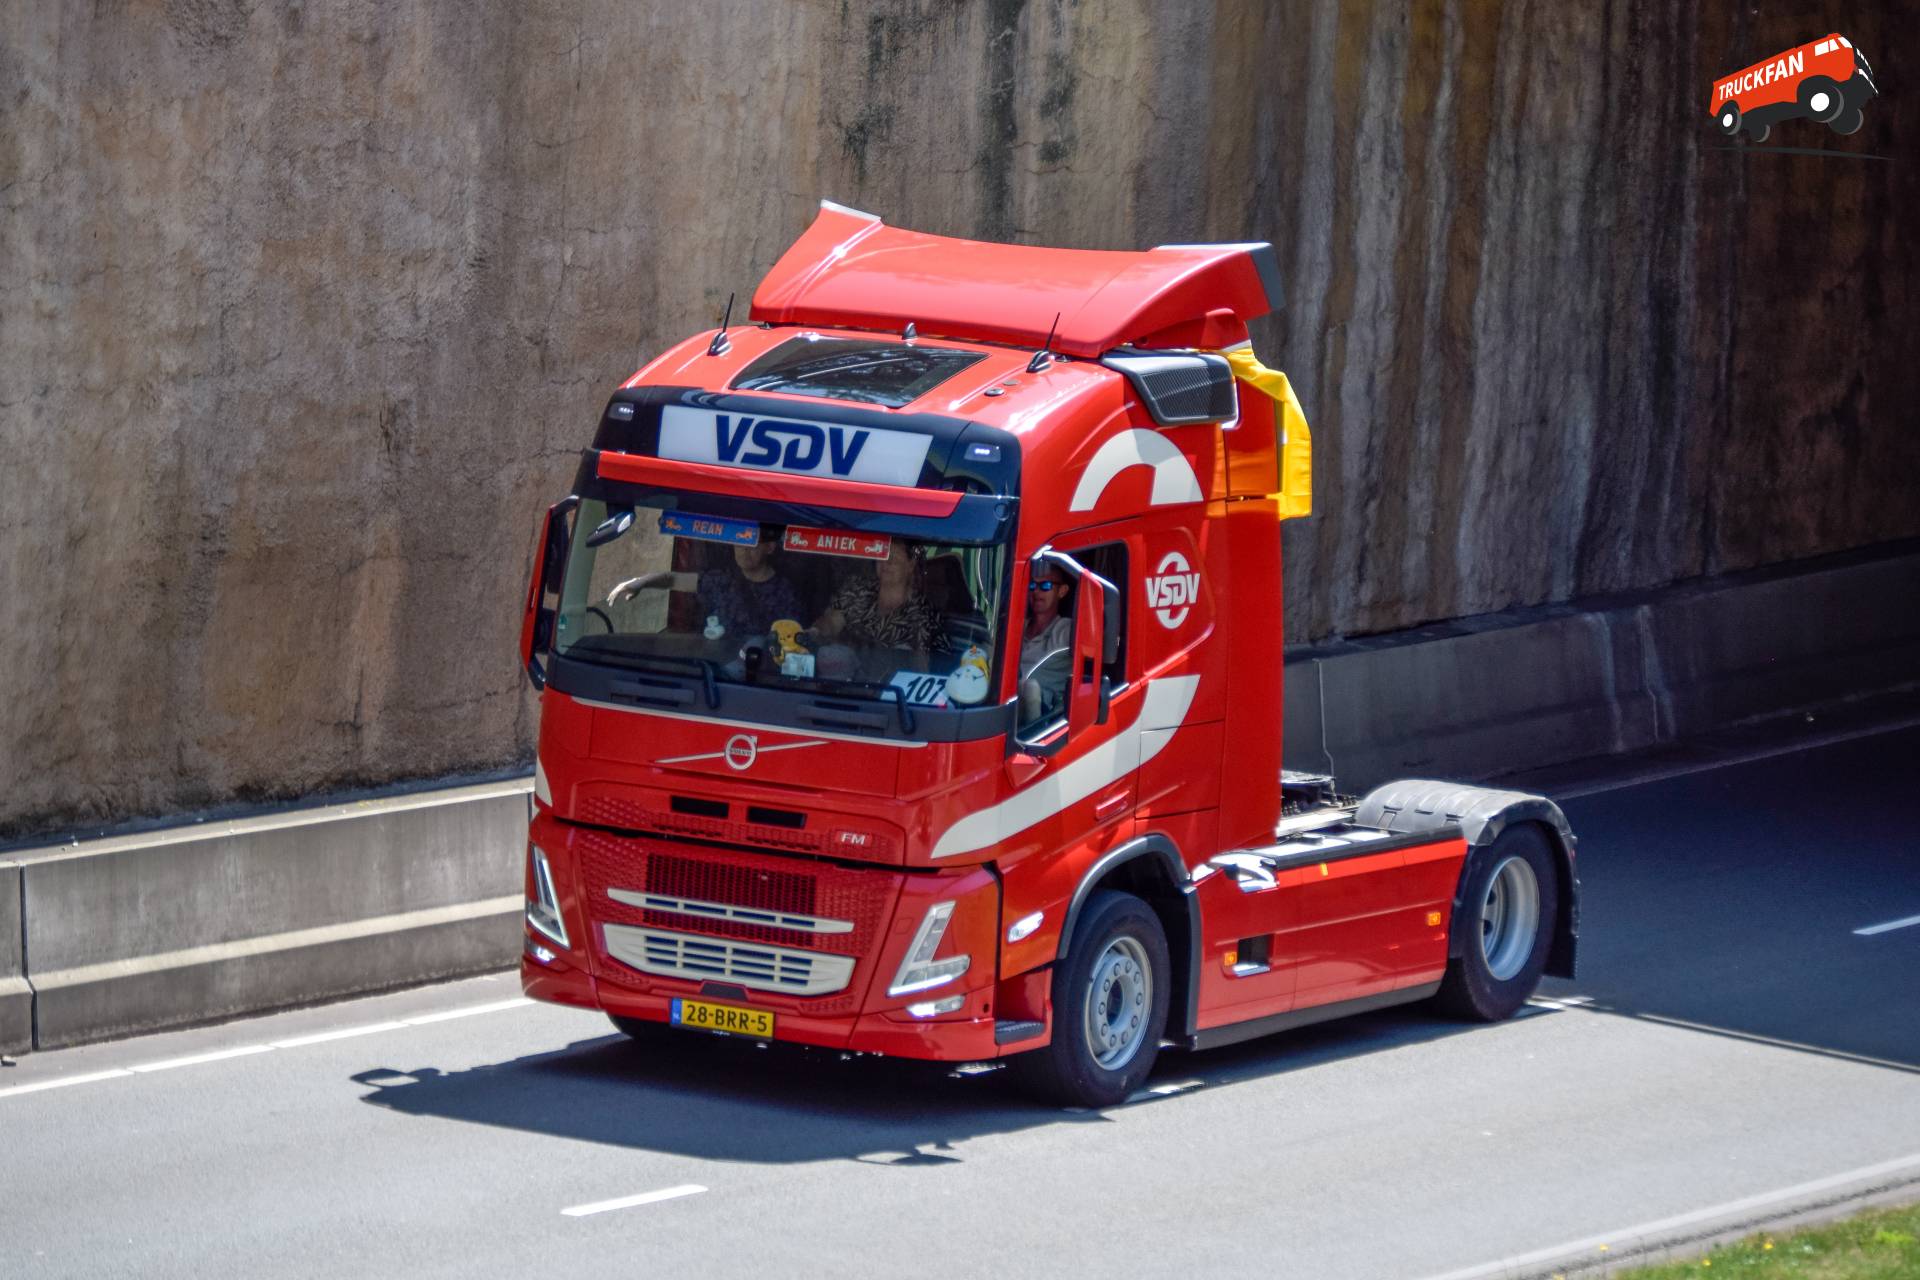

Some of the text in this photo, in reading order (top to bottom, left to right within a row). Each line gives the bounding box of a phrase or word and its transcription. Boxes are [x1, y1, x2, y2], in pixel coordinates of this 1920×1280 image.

[716, 414, 870, 476] VSDV
[816, 533, 857, 551] ANIEK
[1145, 573, 1200, 608] VSDV
[906, 676, 947, 704] 107
[841, 832, 866, 845] FM
[686, 1004, 768, 1032] 28-BRR-5
